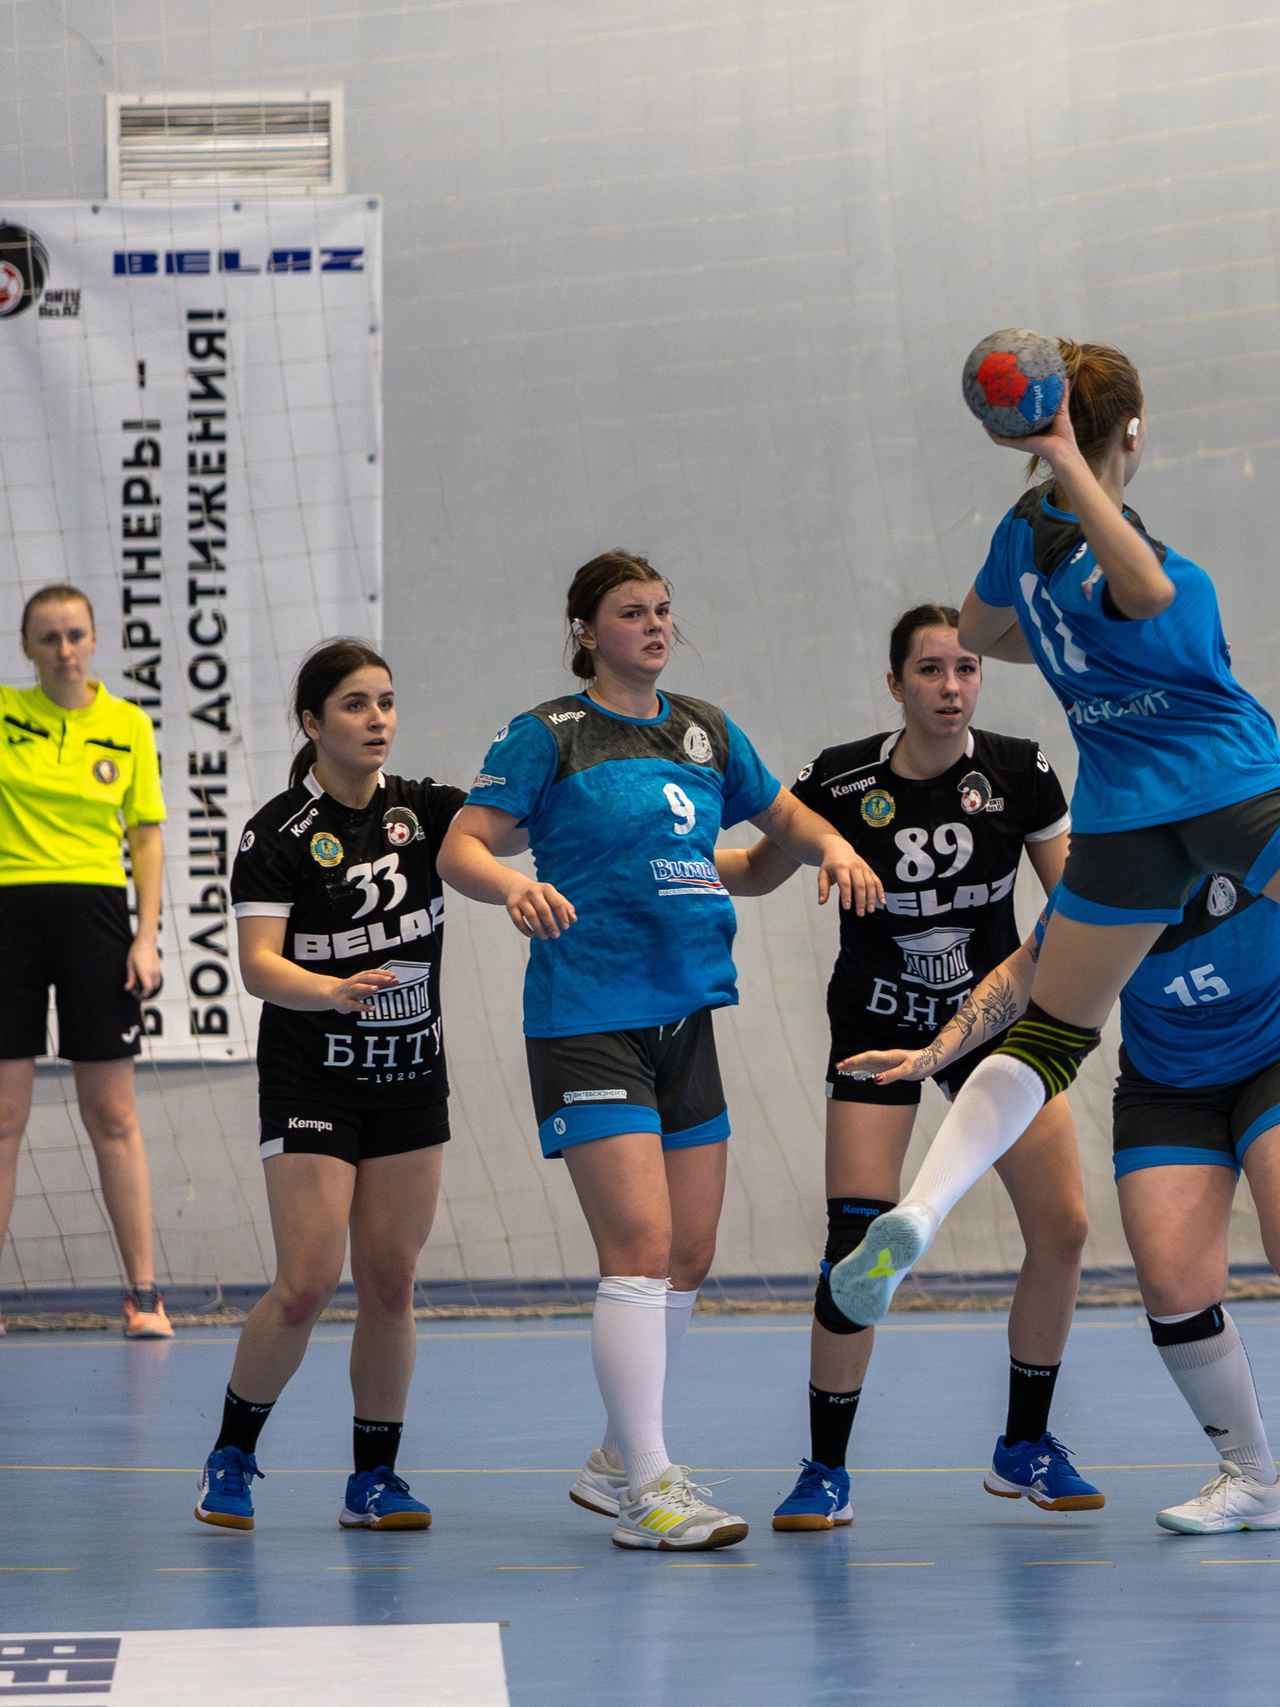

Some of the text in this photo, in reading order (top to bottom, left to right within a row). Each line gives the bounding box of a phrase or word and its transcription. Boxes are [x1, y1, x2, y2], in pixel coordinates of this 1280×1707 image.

[113, 248, 364, 276] BELAZ
[1033, 384, 1044, 421] Kempa
[187, 309, 232, 1037] БОЛЬШИЕ ДОСТИЖЕНИЯ!
[549, 709, 587, 726] Kempa
[831, 776, 877, 798] Kempa
[663, 783, 696, 835] 9
[894, 822, 974, 883] 89
[346, 853, 408, 919] 33
[875, 867, 1017, 917] ELAZ
[866, 977, 972, 1026] БНТ
[1163, 963, 1231, 1007] 15
[375, 1071, 416, 1083] 1920
[288, 1117, 333, 1132] Kempa
[842, 1204, 880, 1217] Kempa
